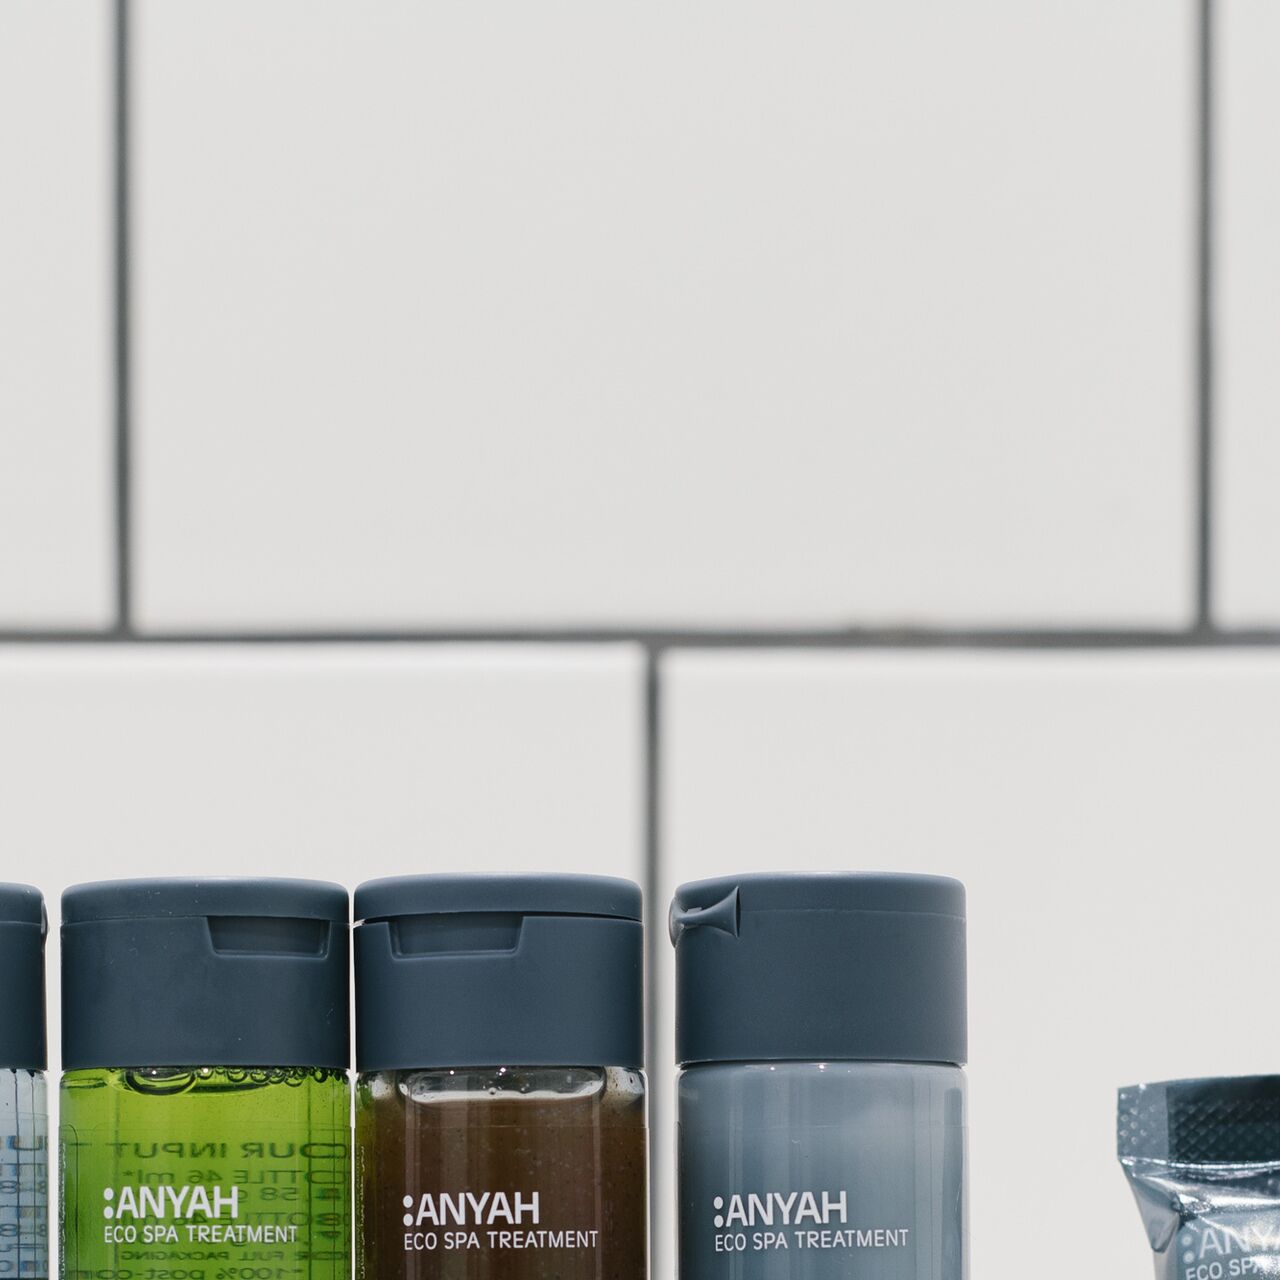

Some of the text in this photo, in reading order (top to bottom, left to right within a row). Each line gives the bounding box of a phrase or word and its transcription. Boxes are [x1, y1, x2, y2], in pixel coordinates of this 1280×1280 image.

[104, 1225, 298, 1243] ECO SPA TREATMENT
[404, 1231, 598, 1250] ECO SPA TREATMENT
[715, 1229, 909, 1252] ECO SPA TREATMENT
